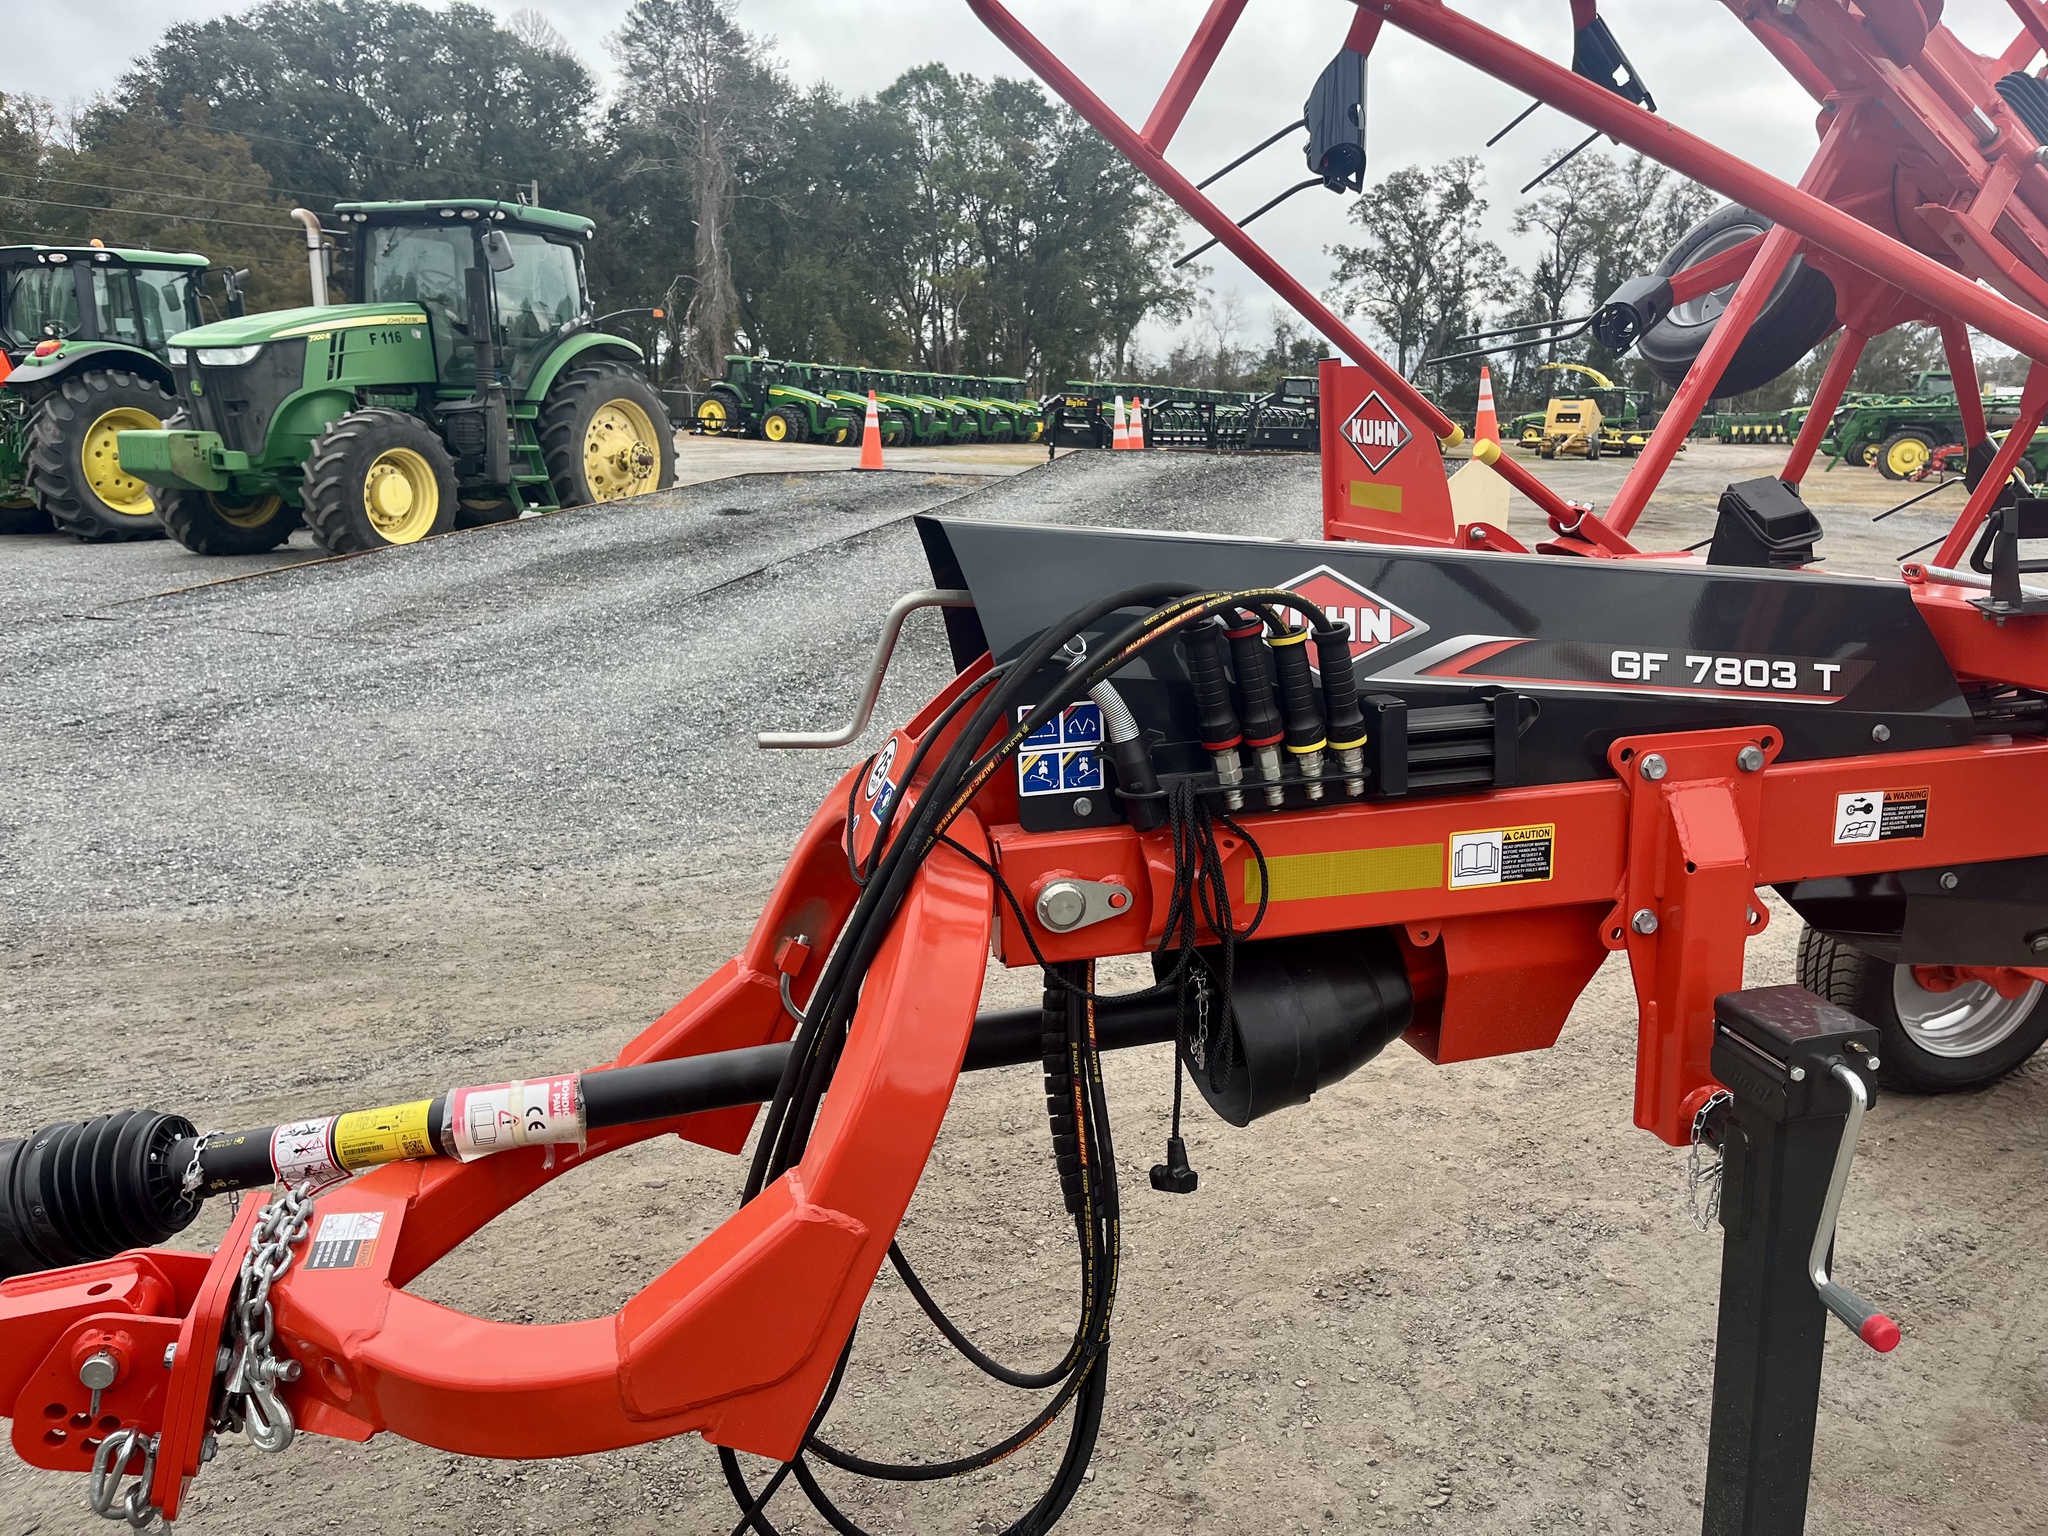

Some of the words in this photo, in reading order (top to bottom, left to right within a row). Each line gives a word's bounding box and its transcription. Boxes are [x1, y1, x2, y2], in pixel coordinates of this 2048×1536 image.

[369, 332, 377, 346] F
[381, 330, 402, 344] 116
[1351, 418, 1399, 448] KUHN
[1153, 613, 1182, 635] PREMIUM
[1611, 650, 1669, 681] GF
[1685, 655, 1797, 689] 7803
[1813, 663, 1841, 691] T
[1001, 731, 1023, 755] BALFLEX
[974, 761, 995, 786] BALPAC
[950, 786, 973, 815] PREMIUM
[1893, 790, 1927, 800] WARNING
[1513, 828, 1550, 840] CAUTION
[1072, 1050, 1080, 1075] BALFLEX
[1091, 1050, 1099, 1075] BALFLEX
[1074, 1086, 1083, 1111] BALPAC
[1077, 1115, 1086, 1143] PREMIUM
